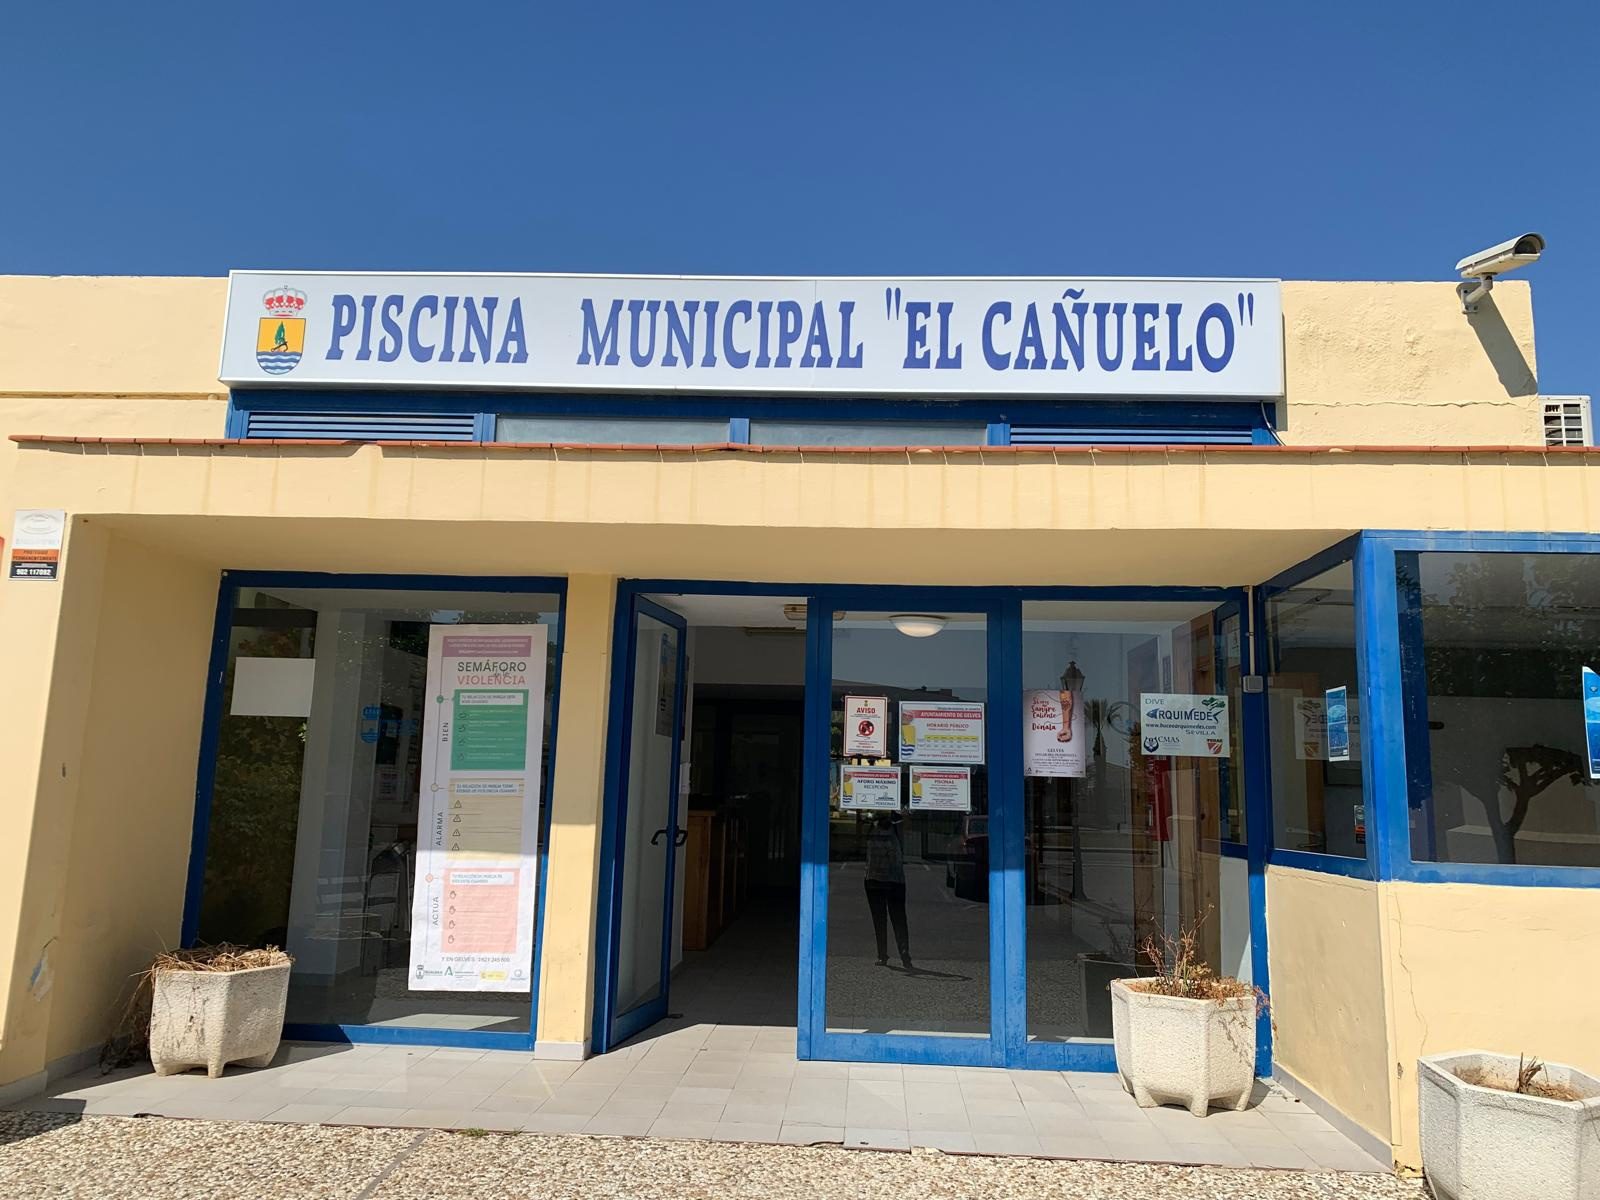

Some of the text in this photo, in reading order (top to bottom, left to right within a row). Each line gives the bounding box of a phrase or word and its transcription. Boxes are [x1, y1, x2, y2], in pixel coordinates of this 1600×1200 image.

[325, 287, 1254, 373] PISCINA MUNICIPAL "EL CAÑUELO"
[457, 659, 527, 672] SEMÁFORO
[457, 675, 526, 685] VIOLENCIA
[1031, 705, 1056, 713] Sangre
[435, 811, 444, 846] ALARMA
